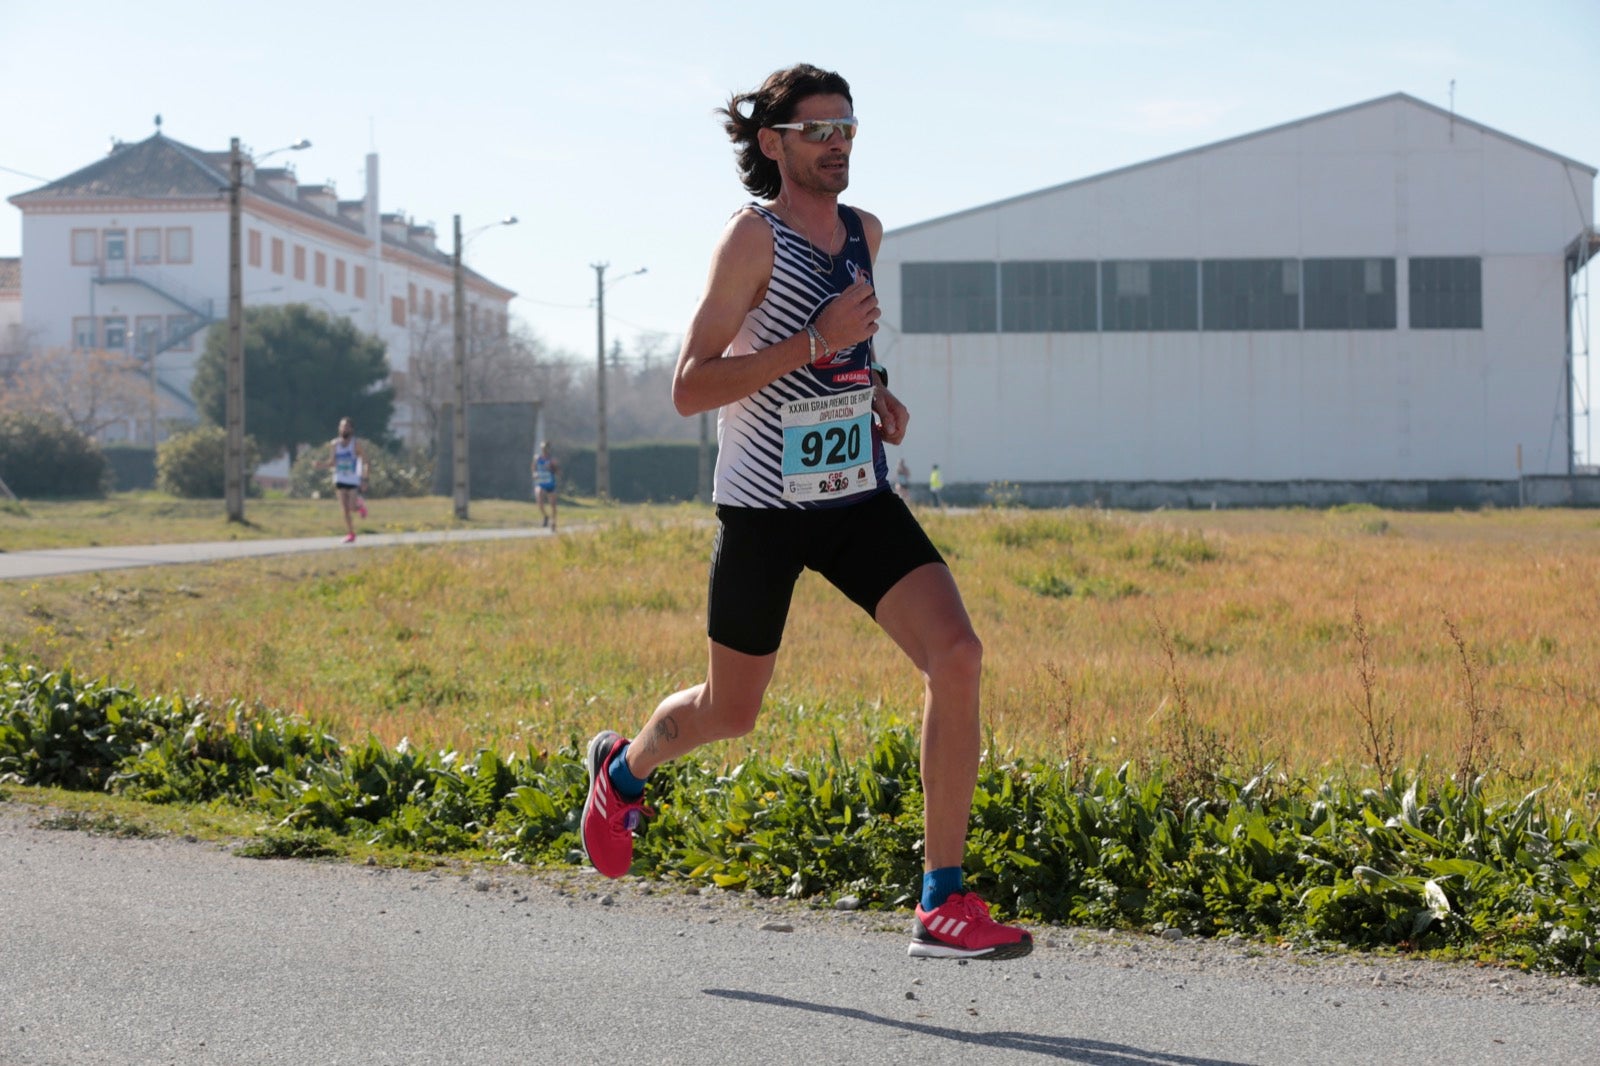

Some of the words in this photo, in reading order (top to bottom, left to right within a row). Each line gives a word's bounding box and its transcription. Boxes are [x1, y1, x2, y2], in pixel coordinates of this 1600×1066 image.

[788, 402, 809, 414] XXXIII
[811, 400, 828, 412] GRAN
[829, 396, 849, 409] PREMIO
[850, 394, 858, 405] DE
[801, 423, 860, 468] 920
